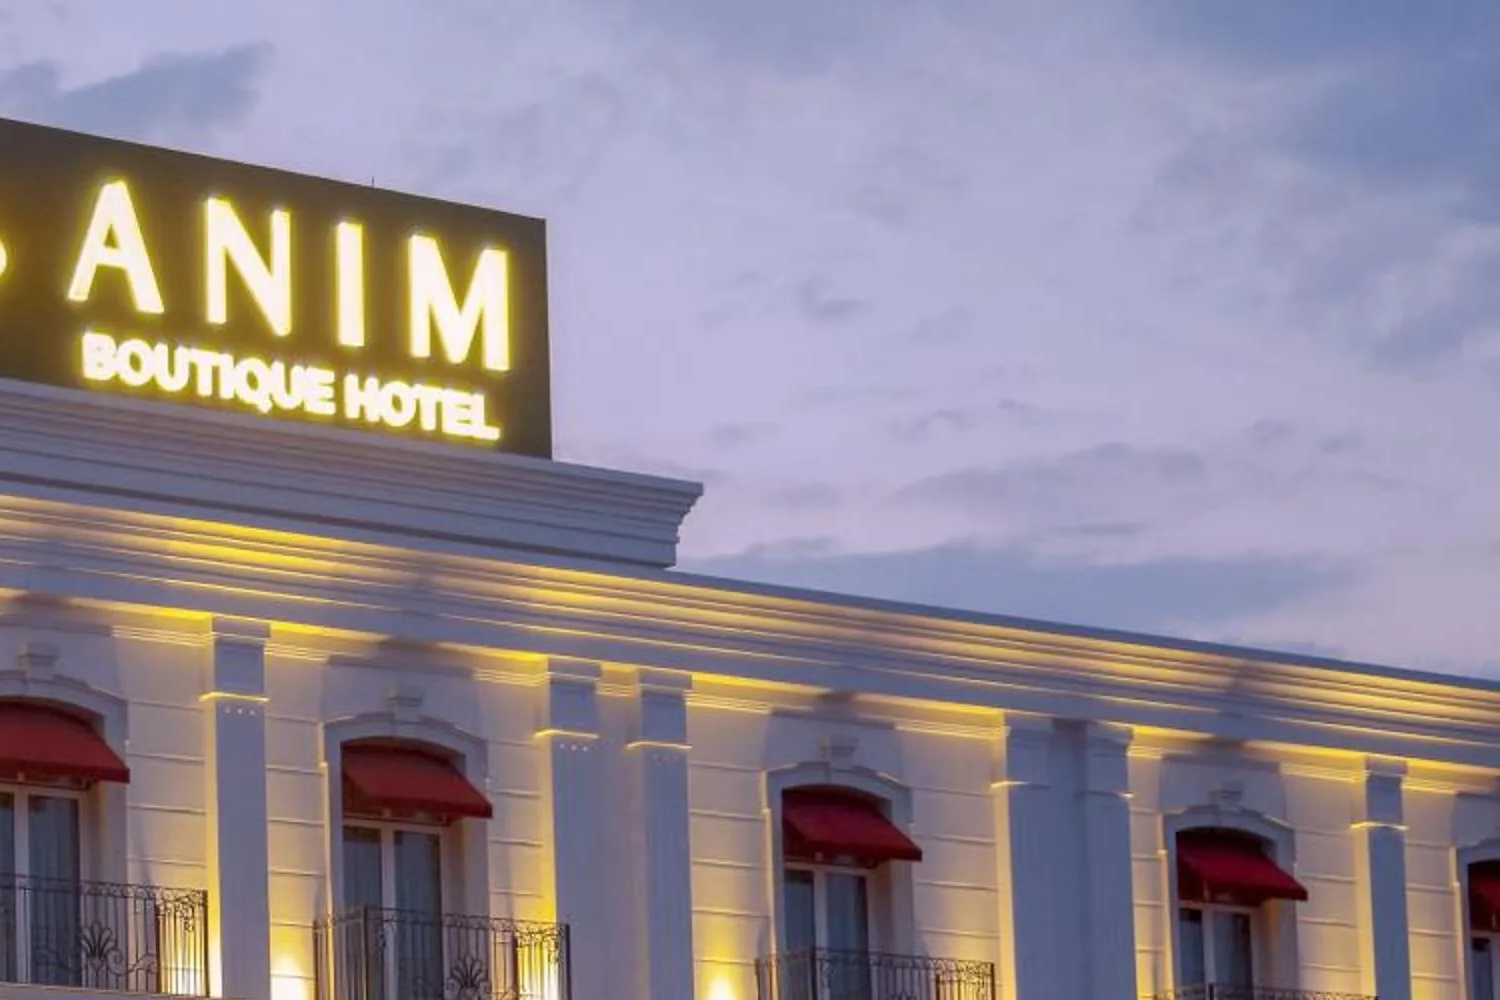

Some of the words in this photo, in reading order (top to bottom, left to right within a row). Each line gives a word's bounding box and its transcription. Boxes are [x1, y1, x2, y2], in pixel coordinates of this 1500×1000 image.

[66, 179, 511, 372] ANIM
[81, 330, 336, 415] BOUTIQUE
[343, 372, 500, 441] HOTEL
